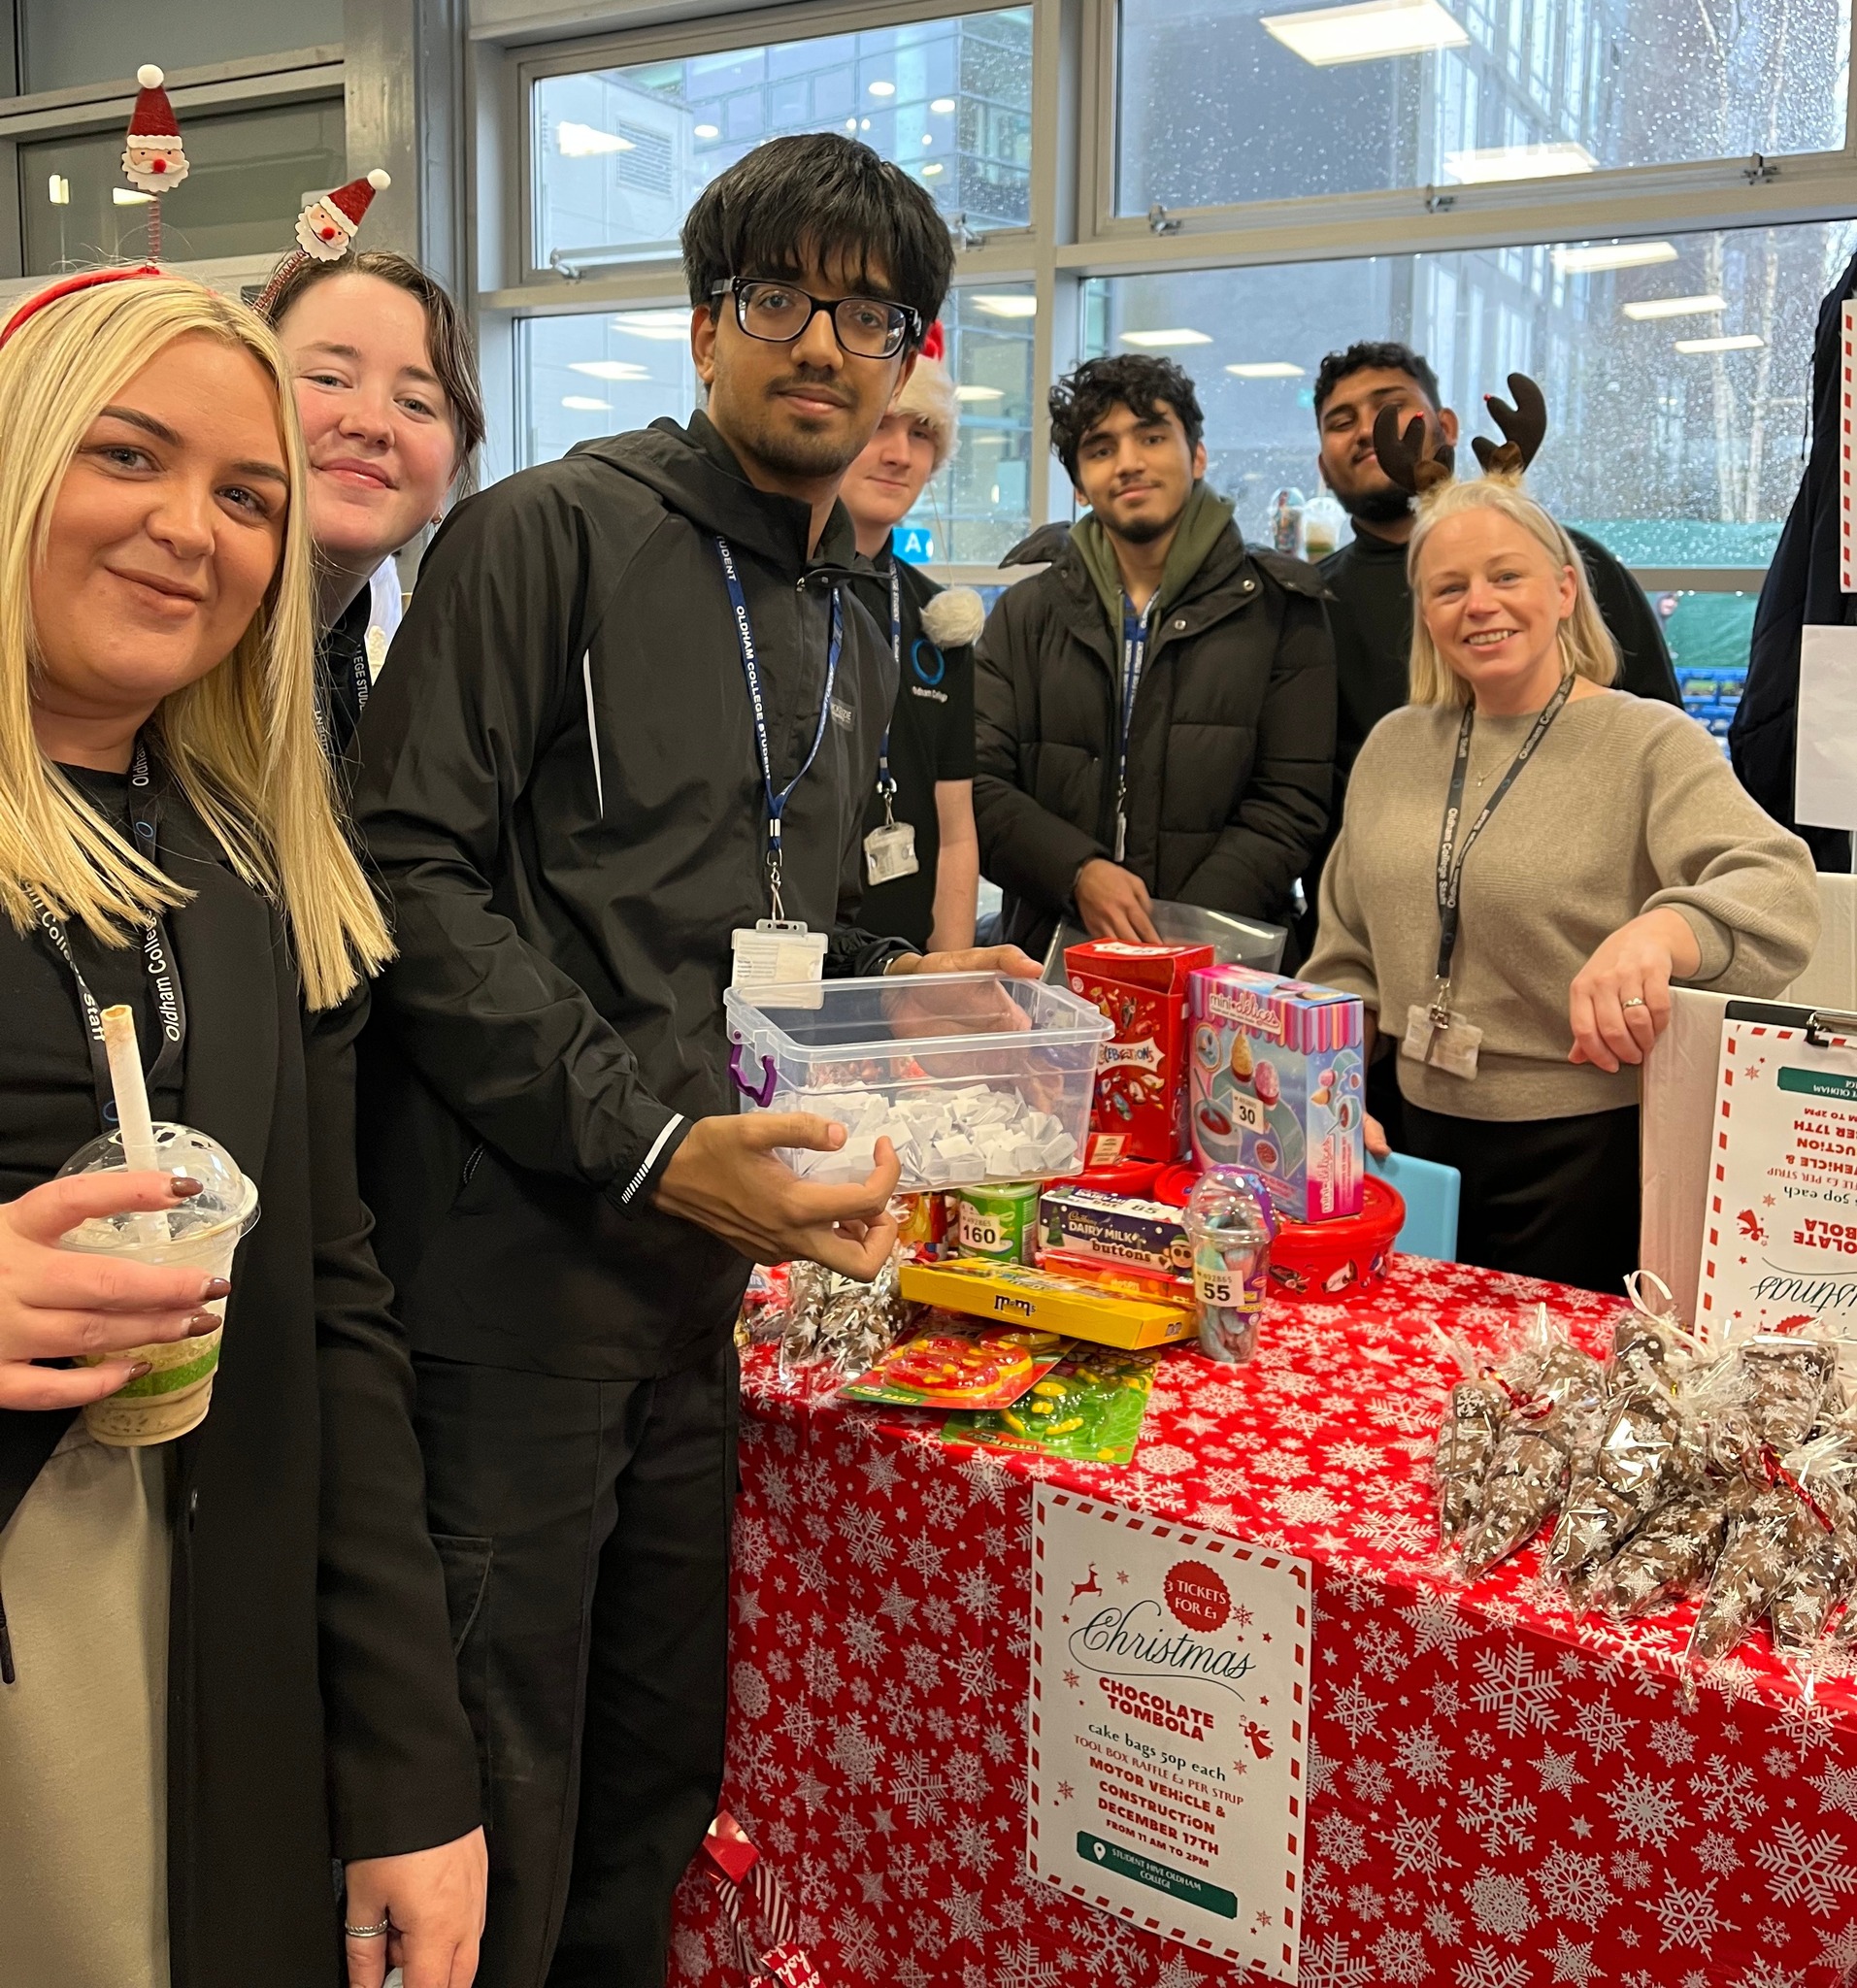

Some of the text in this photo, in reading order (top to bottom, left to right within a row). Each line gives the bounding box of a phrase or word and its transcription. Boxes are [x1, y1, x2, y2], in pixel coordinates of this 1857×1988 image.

[905, 532, 921, 553] A
[716, 536, 737, 581] TUDENT
[736, 605, 772, 780] OLDHAM COLLEGE STUDENT
[1438, 808, 1458, 906] Oldham College Staff
[158, 976, 181, 1043] Oldham
[1239, 1105, 1256, 1125] 30
[1804, 1108, 1828, 1118] 2PM
[1831, 1111, 1845, 1120] TO
[1794, 1120, 1831, 1135] 17TH
[1796, 1137, 1857, 1157] UCTiON
[1767, 1168, 1798, 1180] STRIP
[1802, 1172, 1822, 1184] PER
[1783, 1186, 1818, 1199] each
[1823, 1189, 1851, 1205] 50p
[964, 1224, 996, 1244] 160
[1069, 1221, 1134, 1243] DAIRY MILK
[1804, 1218, 1857, 1241] BOLA
[1091, 1239, 1151, 1263] buttons
[1794, 1231, 1857, 1254] OLATE
[1204, 1281, 1231, 1302] 55
[1166, 1580, 1227, 1605] 3 TICKETS
[1175, 1597, 1217, 1620] FOR £1
[1076, 1600, 1256, 1681] Christmas
[1099, 1676, 1214, 1730] CHOCOLATE
[1107, 1694, 1205, 1742] TOMBOLA
[1088, 1723, 1226, 1781] cake bags 50p each
[1074, 1735, 1103, 1753] TOOL
[1106, 1747, 1129, 1764] BOX
[1132, 1758, 1169, 1779] RAFFLE
[1188, 1779, 1209, 1795] PER
[1212, 1787, 1244, 1806] STRIP
[1089, 1756, 1144, 1788] MOTOR
[1215, 1806, 1226, 1818] &
[1098, 1797, 1219, 1856] DECEMBER 17TH
[1106, 1819, 1210, 1868] FROM 11 AM TO 2PM
[1111, 1847, 1202, 1892] STUDENT HIVE OLDHAM
[1140, 1870, 1172, 1890] COLLEGE
